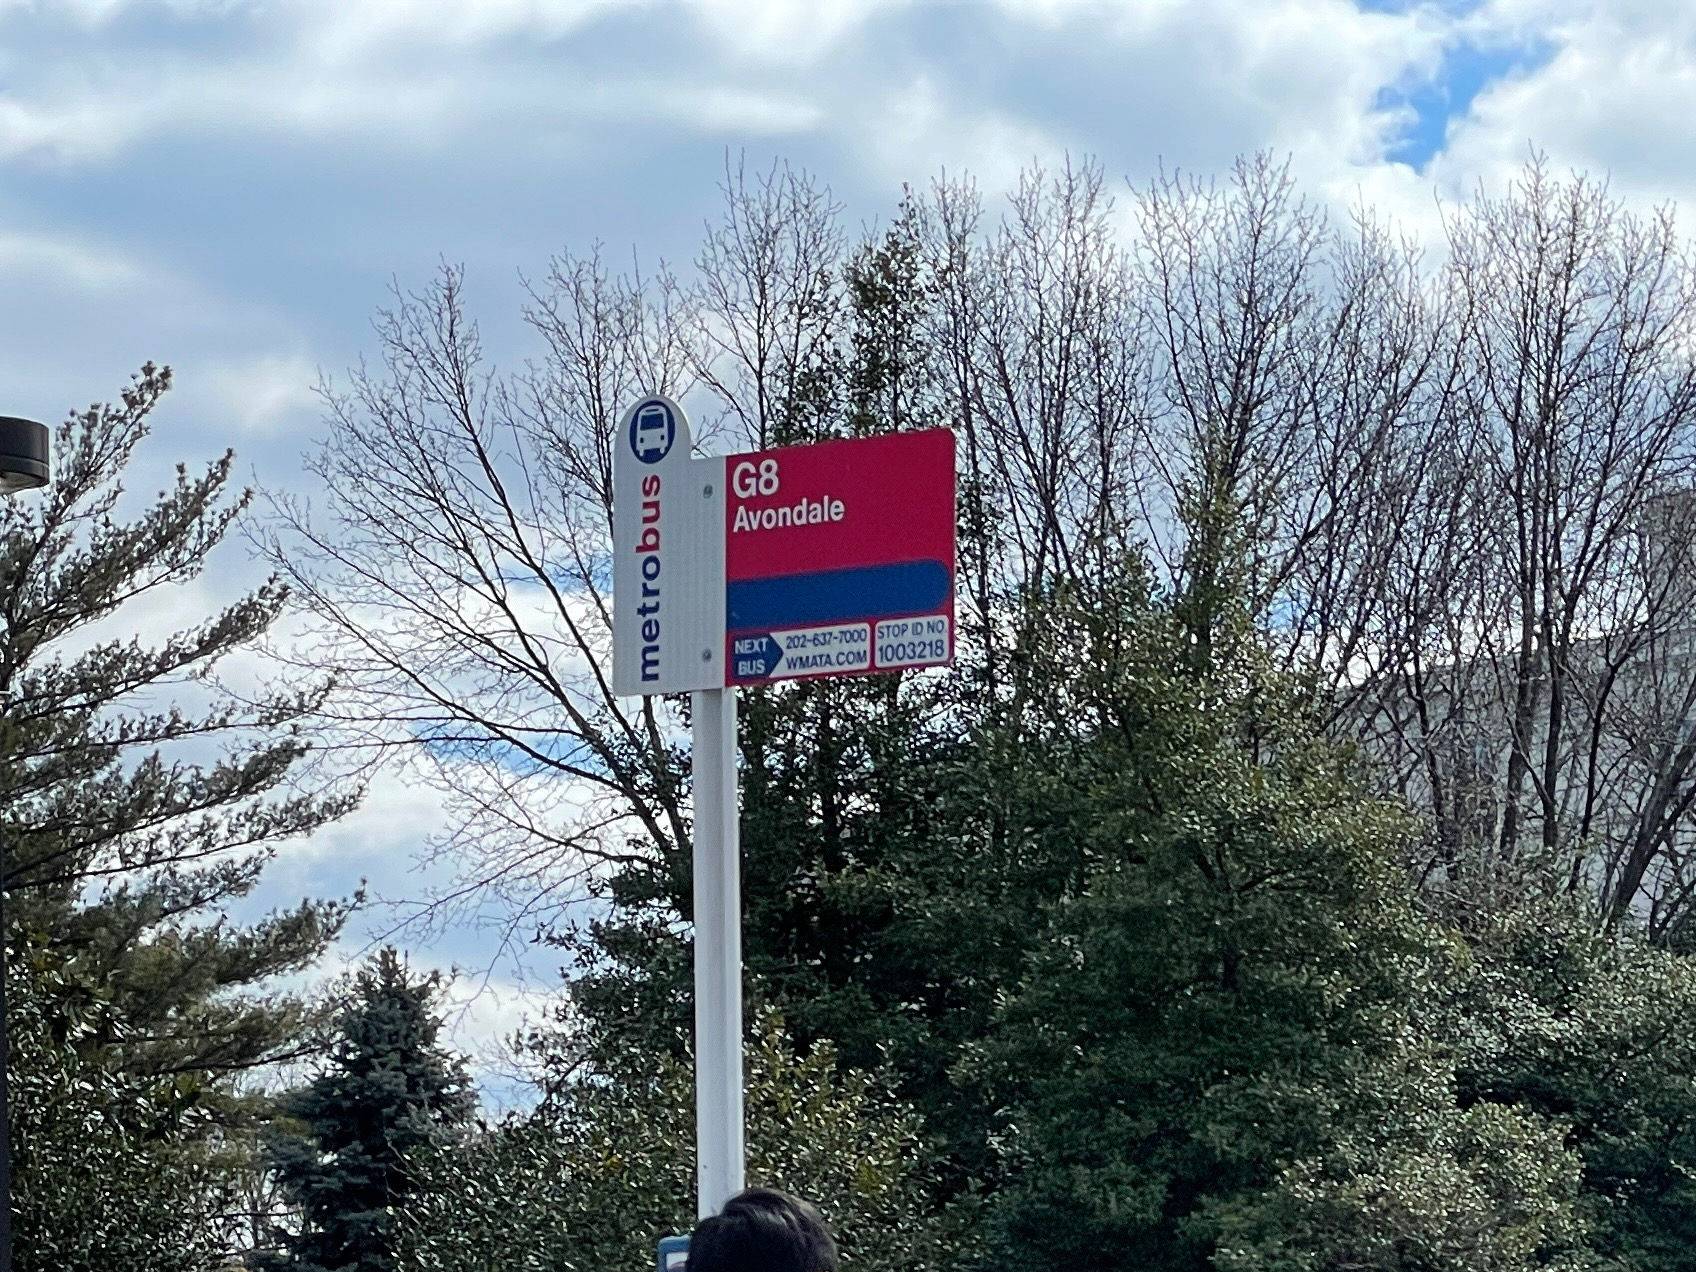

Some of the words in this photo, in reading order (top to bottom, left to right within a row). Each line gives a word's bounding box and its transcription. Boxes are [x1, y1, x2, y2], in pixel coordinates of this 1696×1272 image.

[732, 458, 779, 499] G8
[732, 495, 846, 533] Avondale
[635, 473, 661, 682] metrobus
[786, 628, 867, 650] 202-637-7000
[877, 623, 909, 640] STOP
[911, 621, 924, 636] ID
[734, 637, 769, 655] NEXT
[878, 639, 945, 663] 1003218
[737, 660, 766, 676] BUS
[786, 649, 867, 671] WMATA.COM
